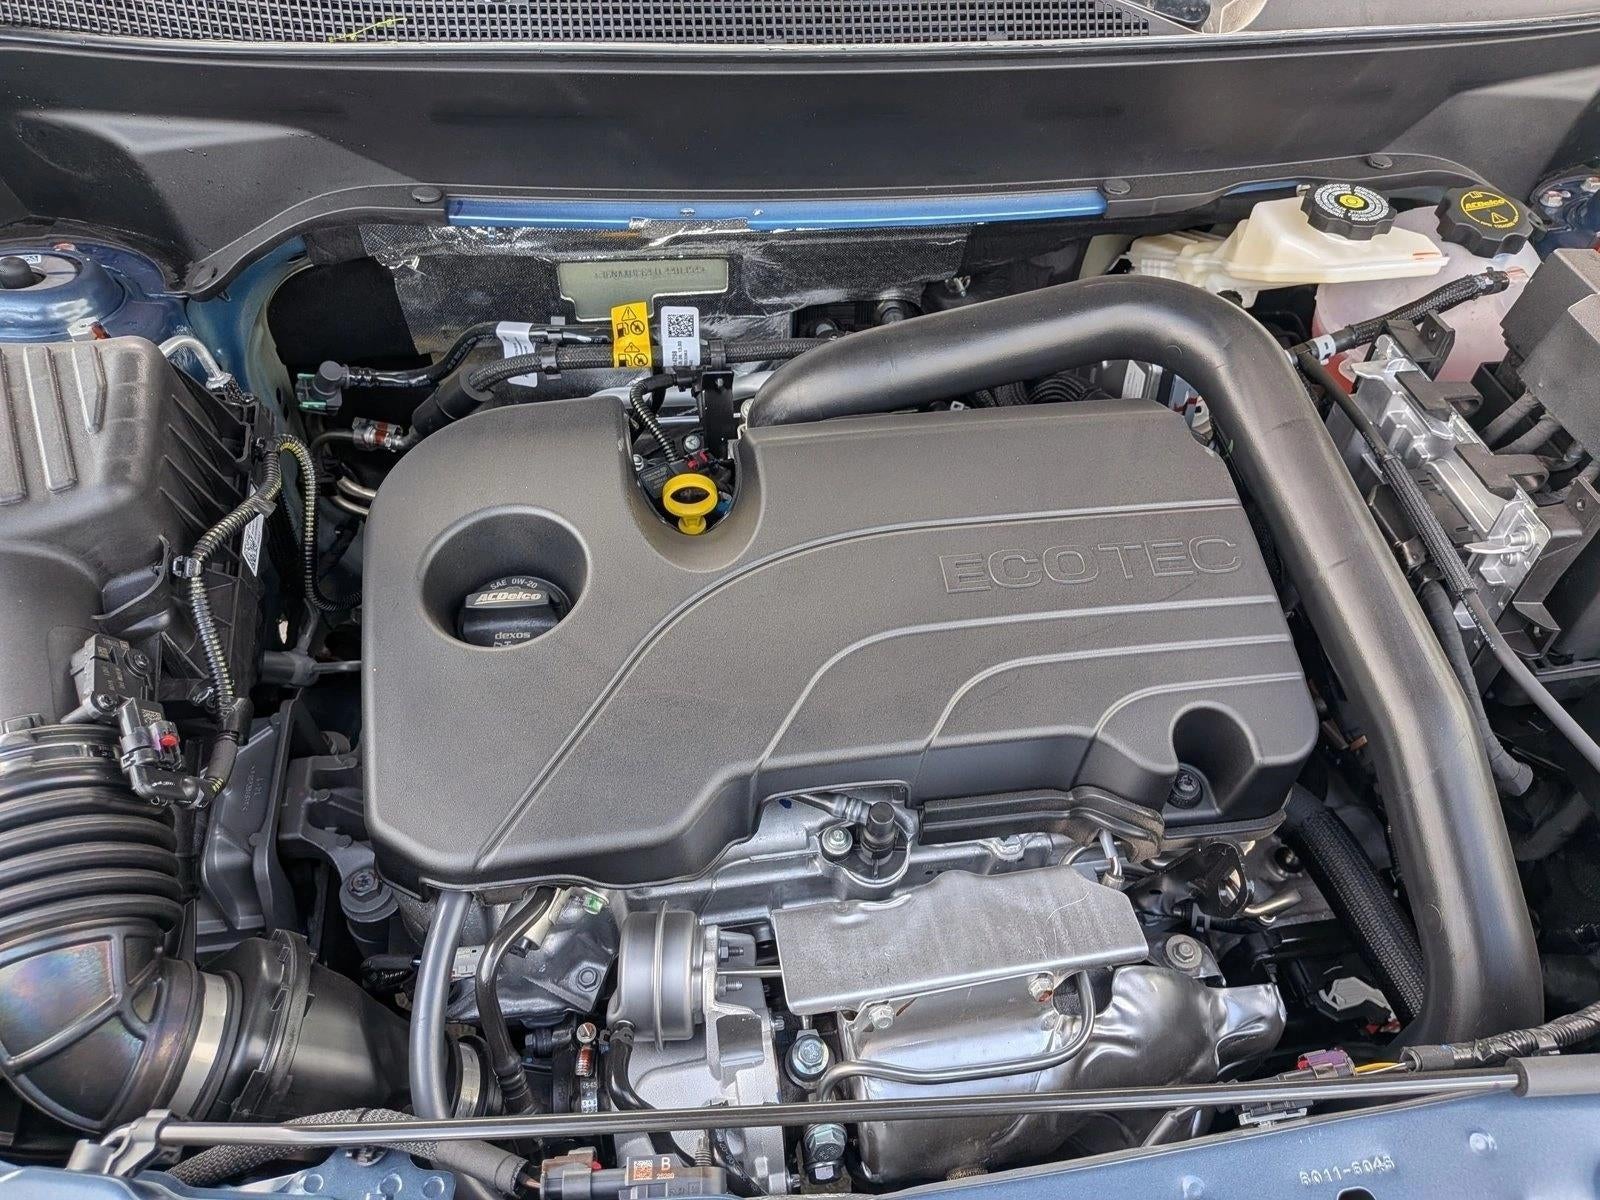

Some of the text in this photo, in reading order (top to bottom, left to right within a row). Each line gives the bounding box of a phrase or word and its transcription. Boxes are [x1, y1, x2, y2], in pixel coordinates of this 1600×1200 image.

[1464, 199, 1505, 211] ACDelco
[938, 535, 1242, 593] ECOTEC
[490, 578, 538, 590] SAE 0W-20
[474, 591, 542, 604] ACDelco
[494, 631, 531, 640] dexos
[661, 1157, 671, 1170] B
